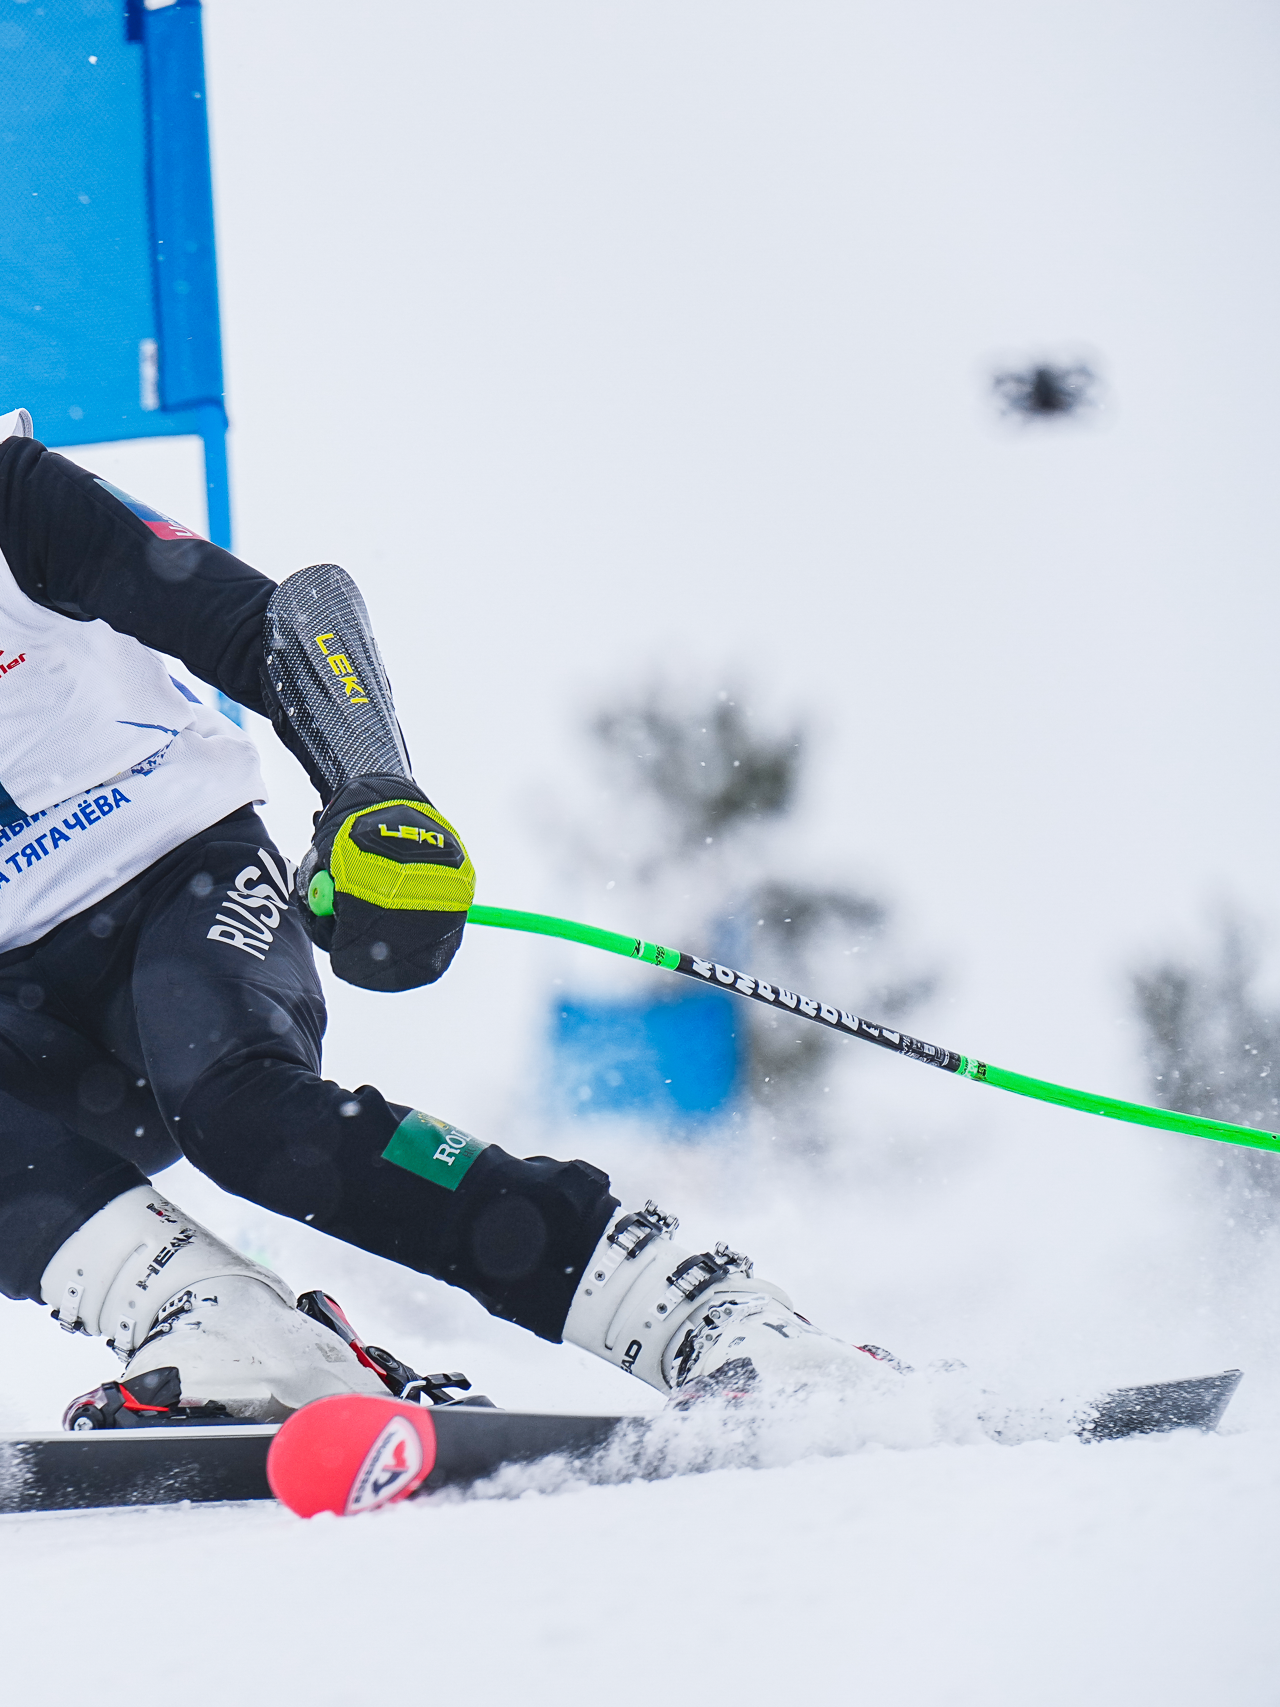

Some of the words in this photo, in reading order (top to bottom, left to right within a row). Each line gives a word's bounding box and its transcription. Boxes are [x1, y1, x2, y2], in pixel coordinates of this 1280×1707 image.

[315, 632, 370, 704] LEKI
[4, 787, 132, 874] ТЯГАЧЁВА
[377, 823, 445, 849] LEKI
